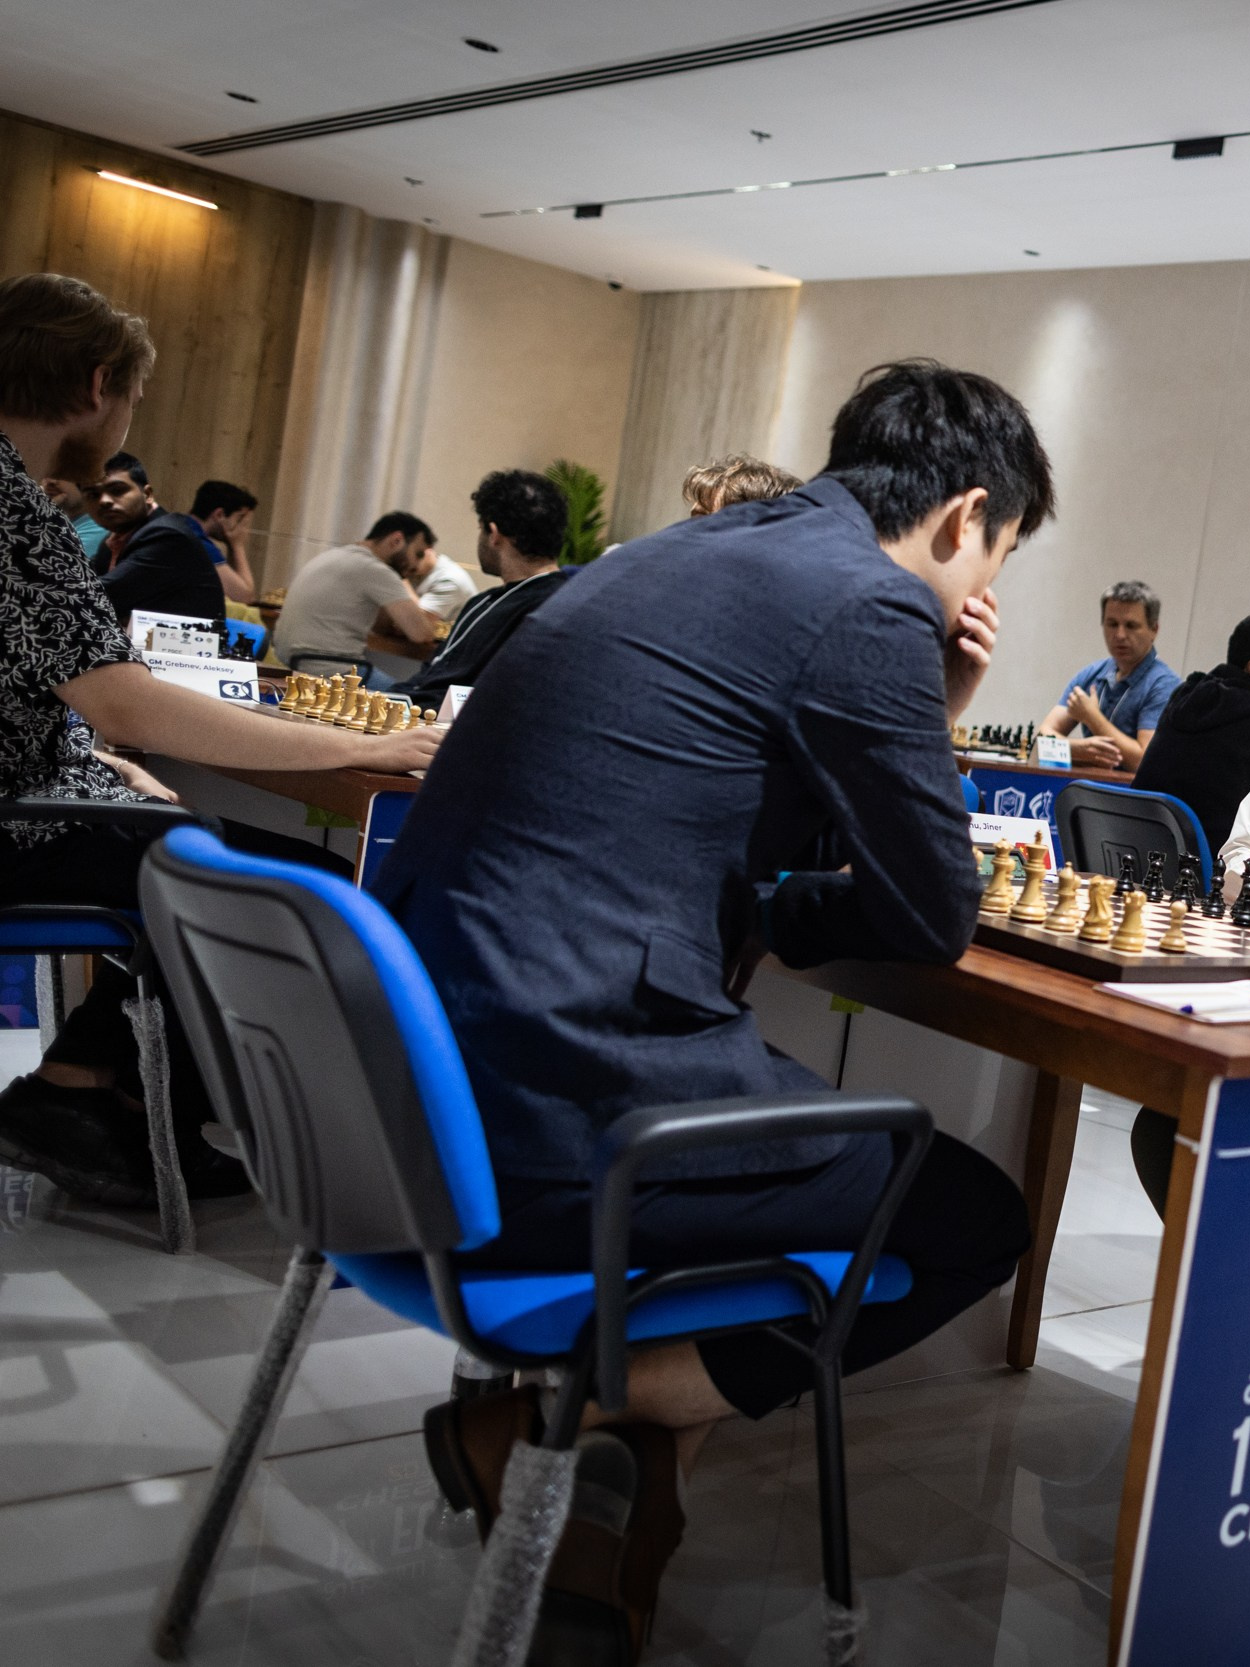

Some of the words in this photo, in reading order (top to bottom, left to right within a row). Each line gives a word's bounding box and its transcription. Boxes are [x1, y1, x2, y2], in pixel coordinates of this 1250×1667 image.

[148, 658, 162, 666] GM
[165, 660, 202, 671] Grebnev,
[203, 664, 235, 674] Aleksey
[983, 822, 1002, 831] Jiner
